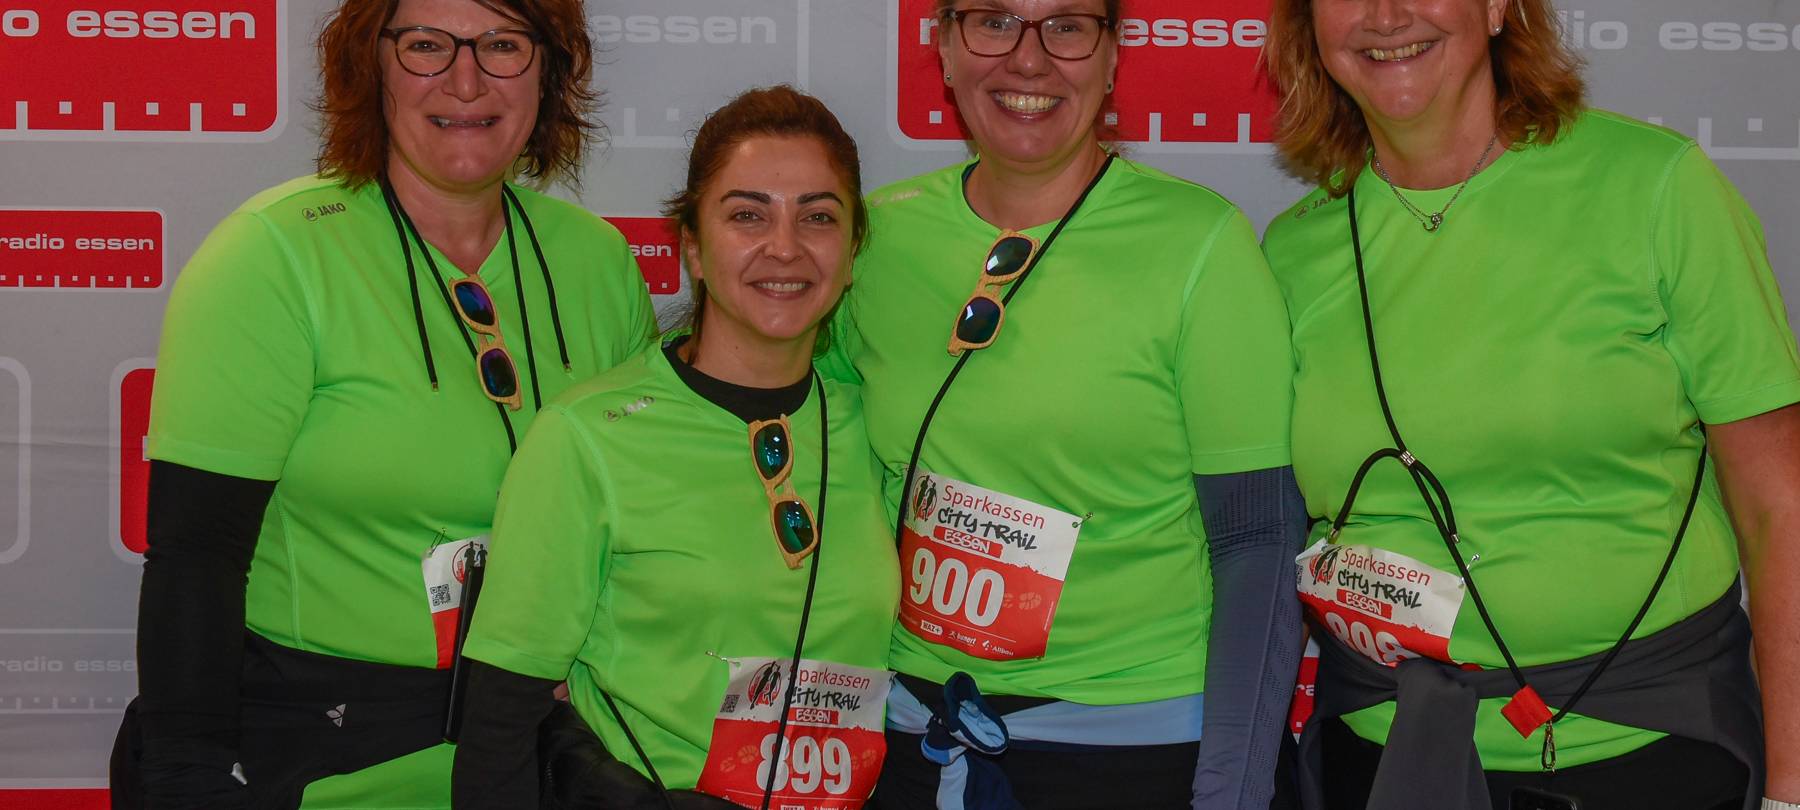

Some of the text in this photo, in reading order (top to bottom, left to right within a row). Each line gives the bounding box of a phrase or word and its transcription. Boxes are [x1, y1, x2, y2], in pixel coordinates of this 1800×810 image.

[66, 10, 256, 39] essen
[591, 15, 777, 44] essen
[1119, 18, 1268, 48] esse
[1658, 21, 1800, 51] ess
[317, 202, 346, 216] JAKO
[0, 233, 155, 251] radio essen
[628, 244, 672, 257] sen
[942, 485, 1046, 530] Sparkassen
[1340, 547, 1431, 587] Sparkassen
[909, 547, 1005, 627] 900
[74, 659, 137, 672] esse
[756, 733, 852, 795] 899
